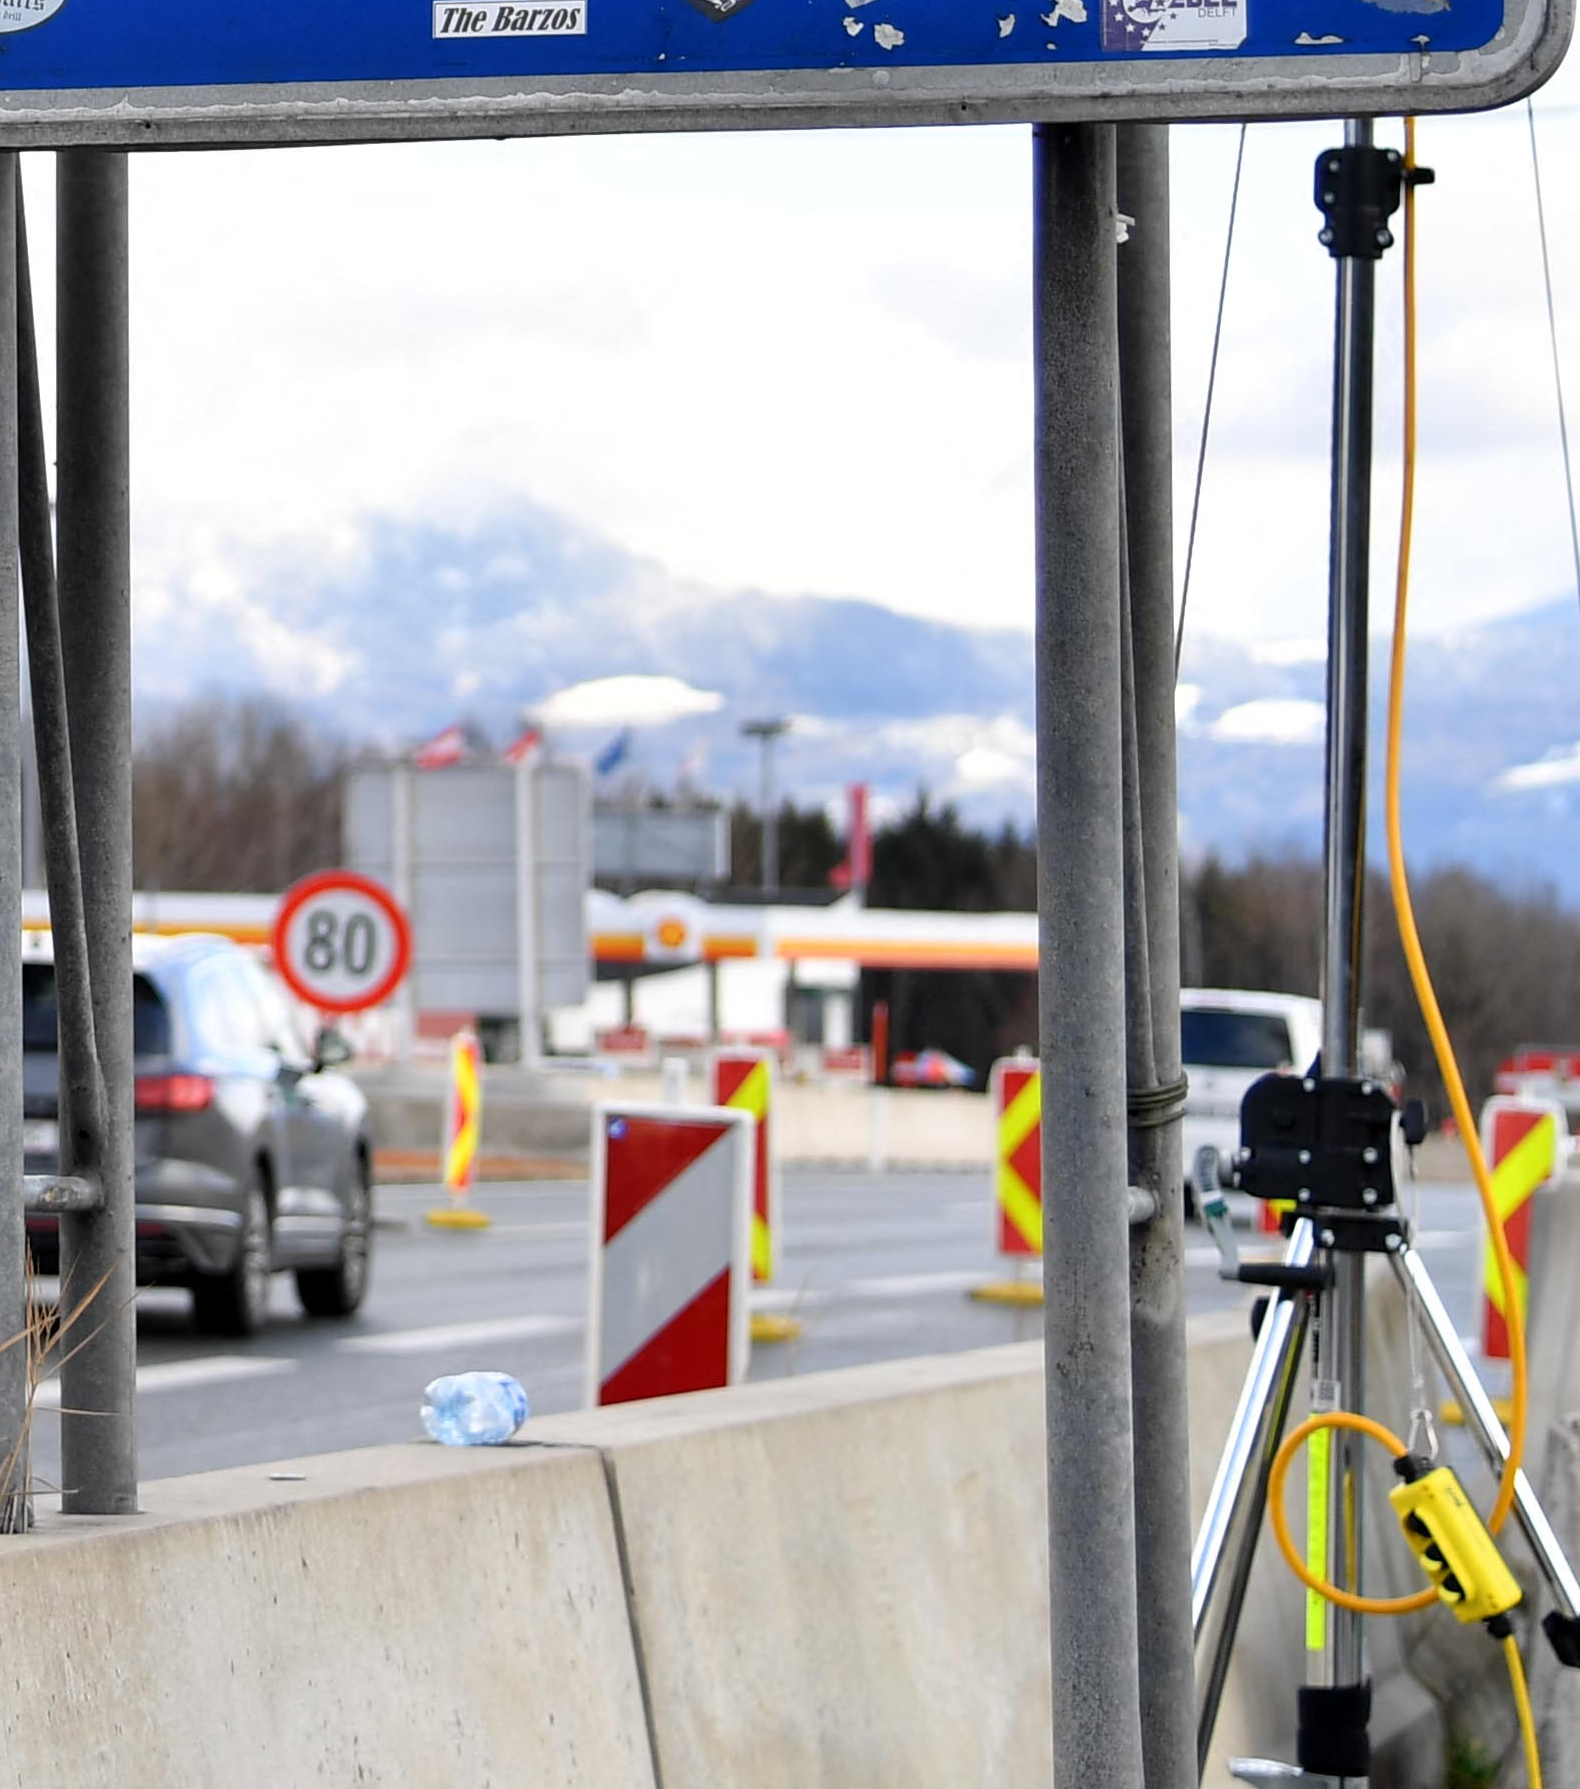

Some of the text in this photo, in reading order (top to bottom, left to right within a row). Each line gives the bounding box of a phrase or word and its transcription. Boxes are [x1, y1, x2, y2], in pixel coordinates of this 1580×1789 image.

[439, 5, 581, 34] The Barzos
[1197, 7, 1237, 19] DELFT
[304, 909, 377, 977] 80
